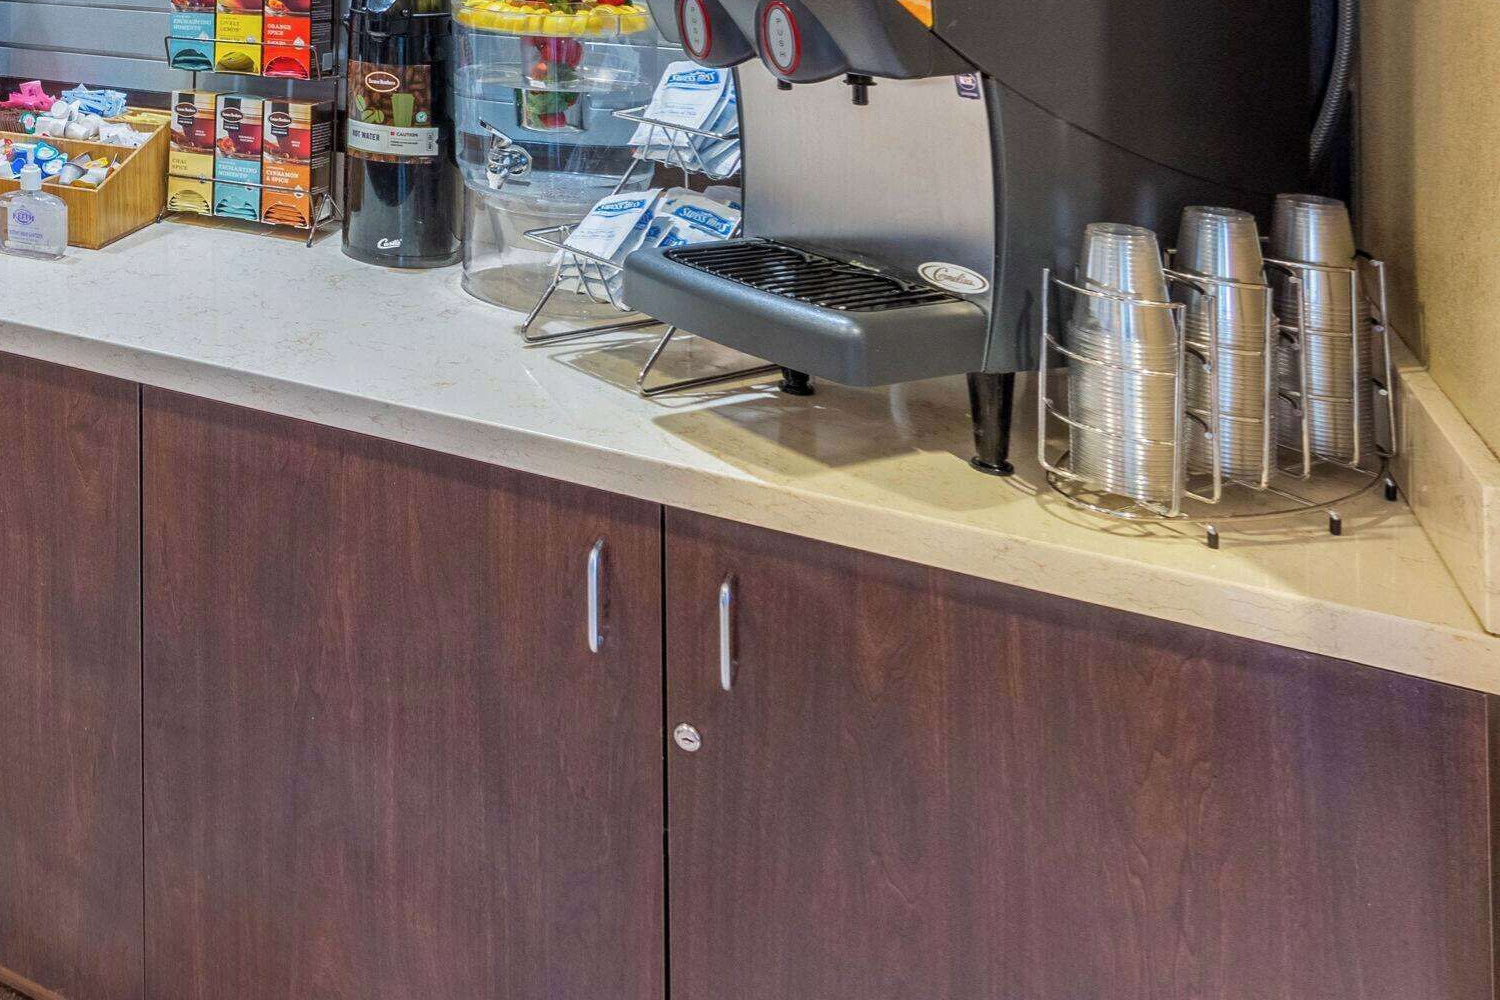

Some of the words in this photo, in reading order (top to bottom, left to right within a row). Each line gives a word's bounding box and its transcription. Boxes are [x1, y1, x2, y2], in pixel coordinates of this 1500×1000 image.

[361, 131, 381, 141] WATER
[396, 130, 419, 138] CAUTION
[680, 206, 708, 224] SWISS
[708, 216, 731, 234] MISS
